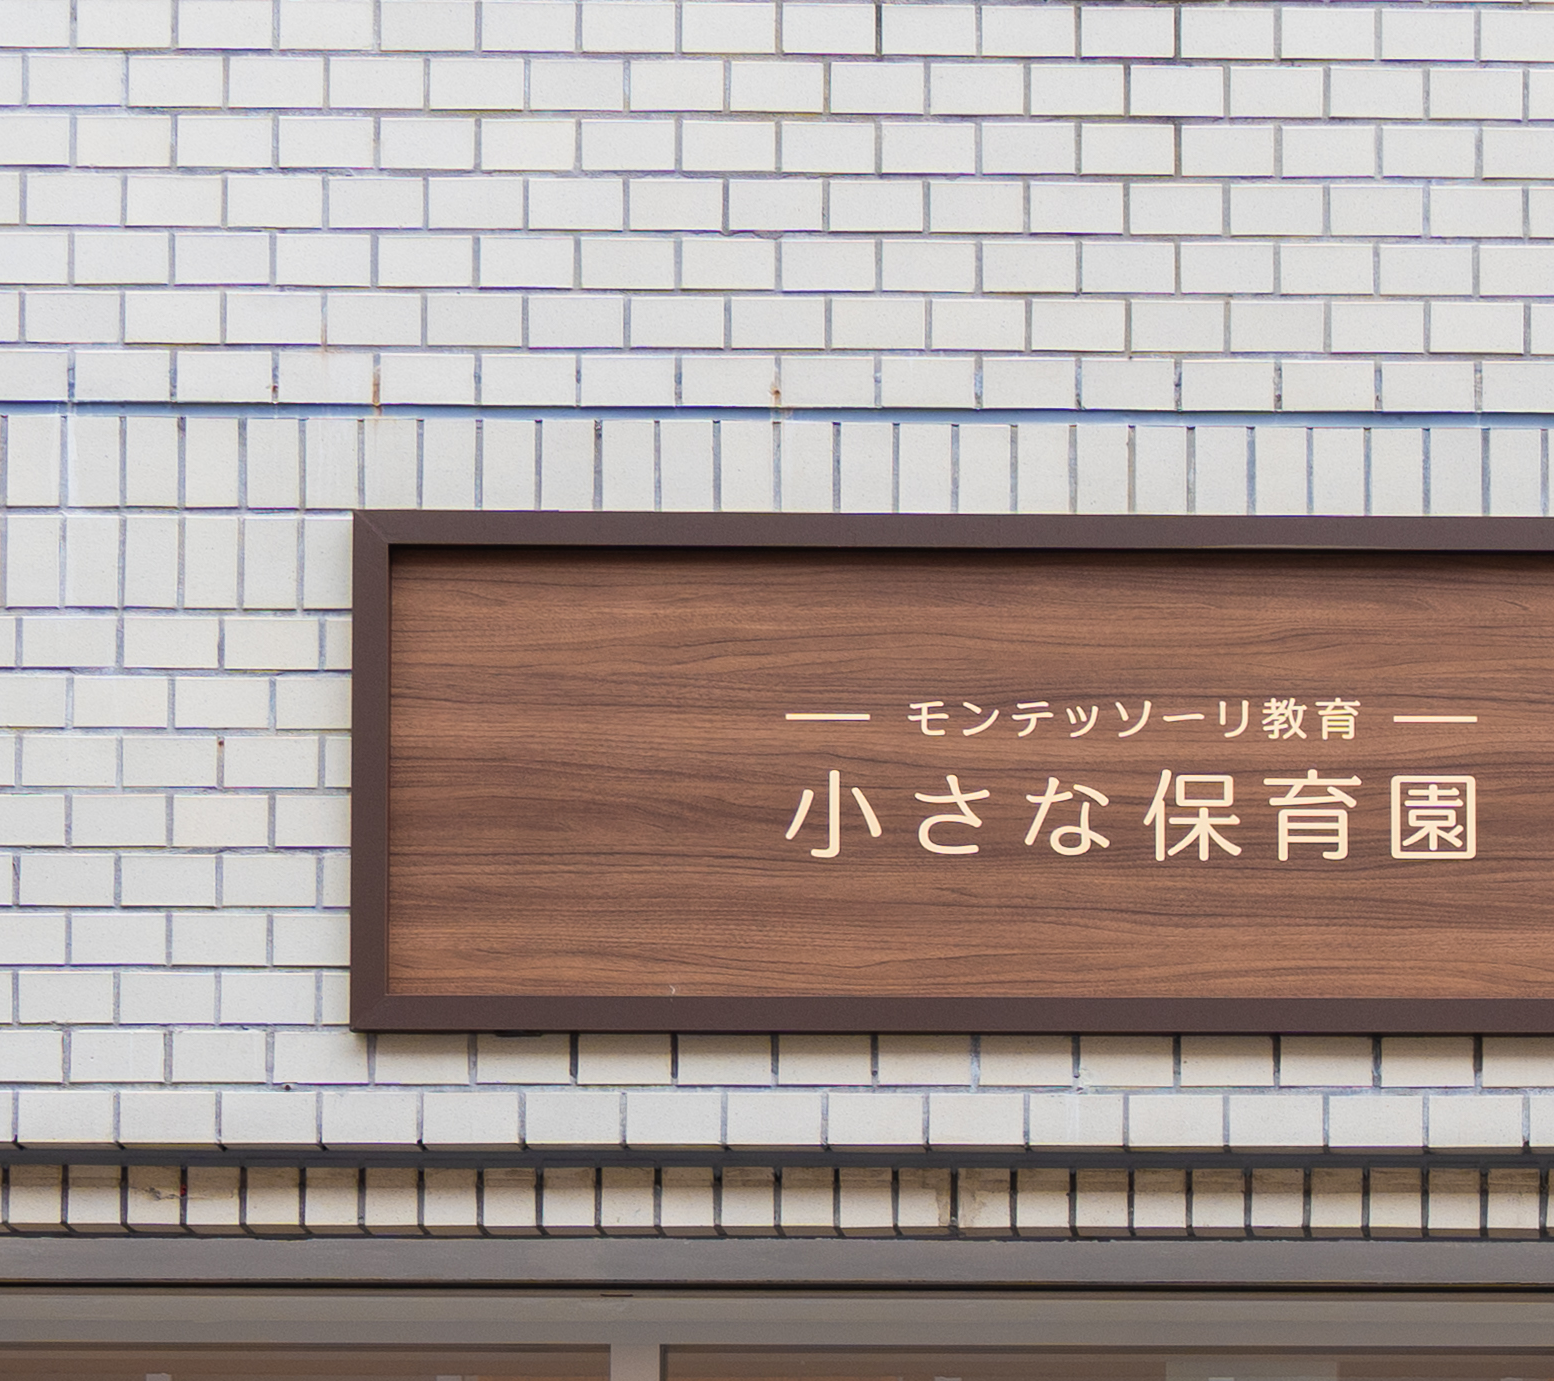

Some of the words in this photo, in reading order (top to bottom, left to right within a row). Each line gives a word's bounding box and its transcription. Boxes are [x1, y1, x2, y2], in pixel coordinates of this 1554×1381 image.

[907, 697, 1361, 741] モンテッソーリ教育
[785, 768, 1477, 862] 小さな保育園
